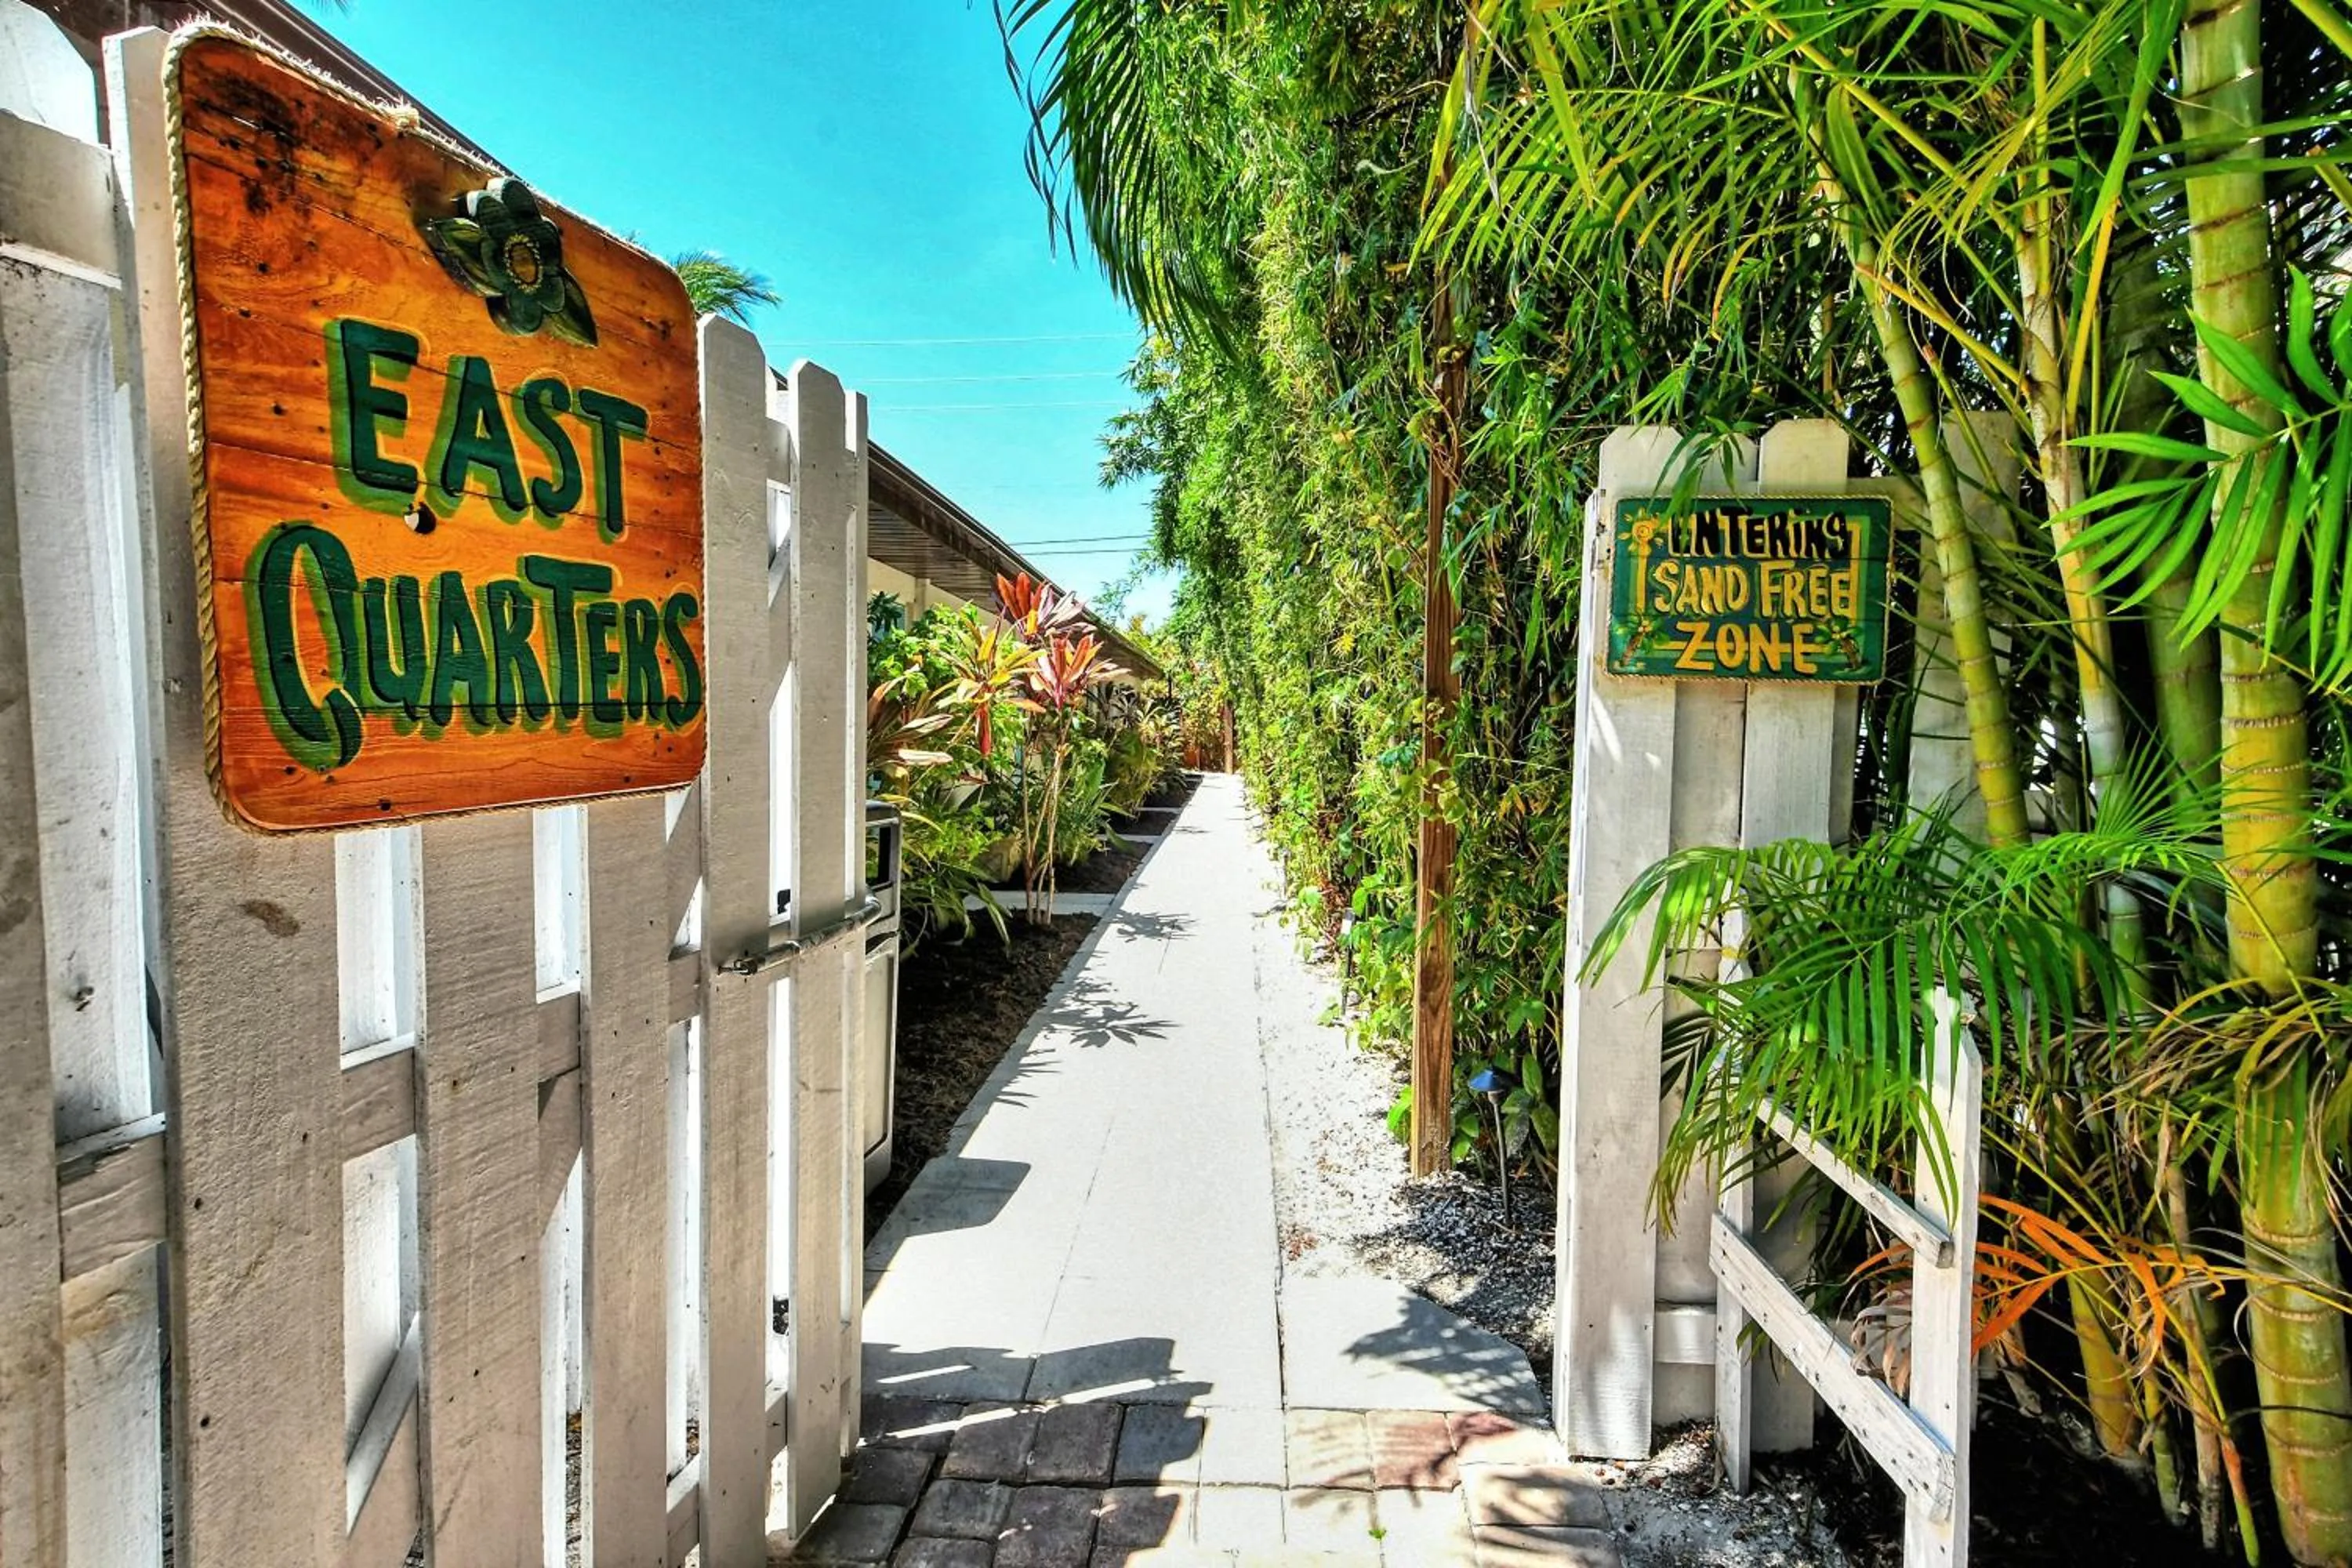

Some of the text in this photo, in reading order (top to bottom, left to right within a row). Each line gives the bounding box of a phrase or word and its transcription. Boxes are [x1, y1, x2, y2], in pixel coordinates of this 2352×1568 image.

[323, 318, 651, 543] EAST
[1652, 560, 1855, 618] SAND FREE
[1675, 621, 1819, 674] ZONE
